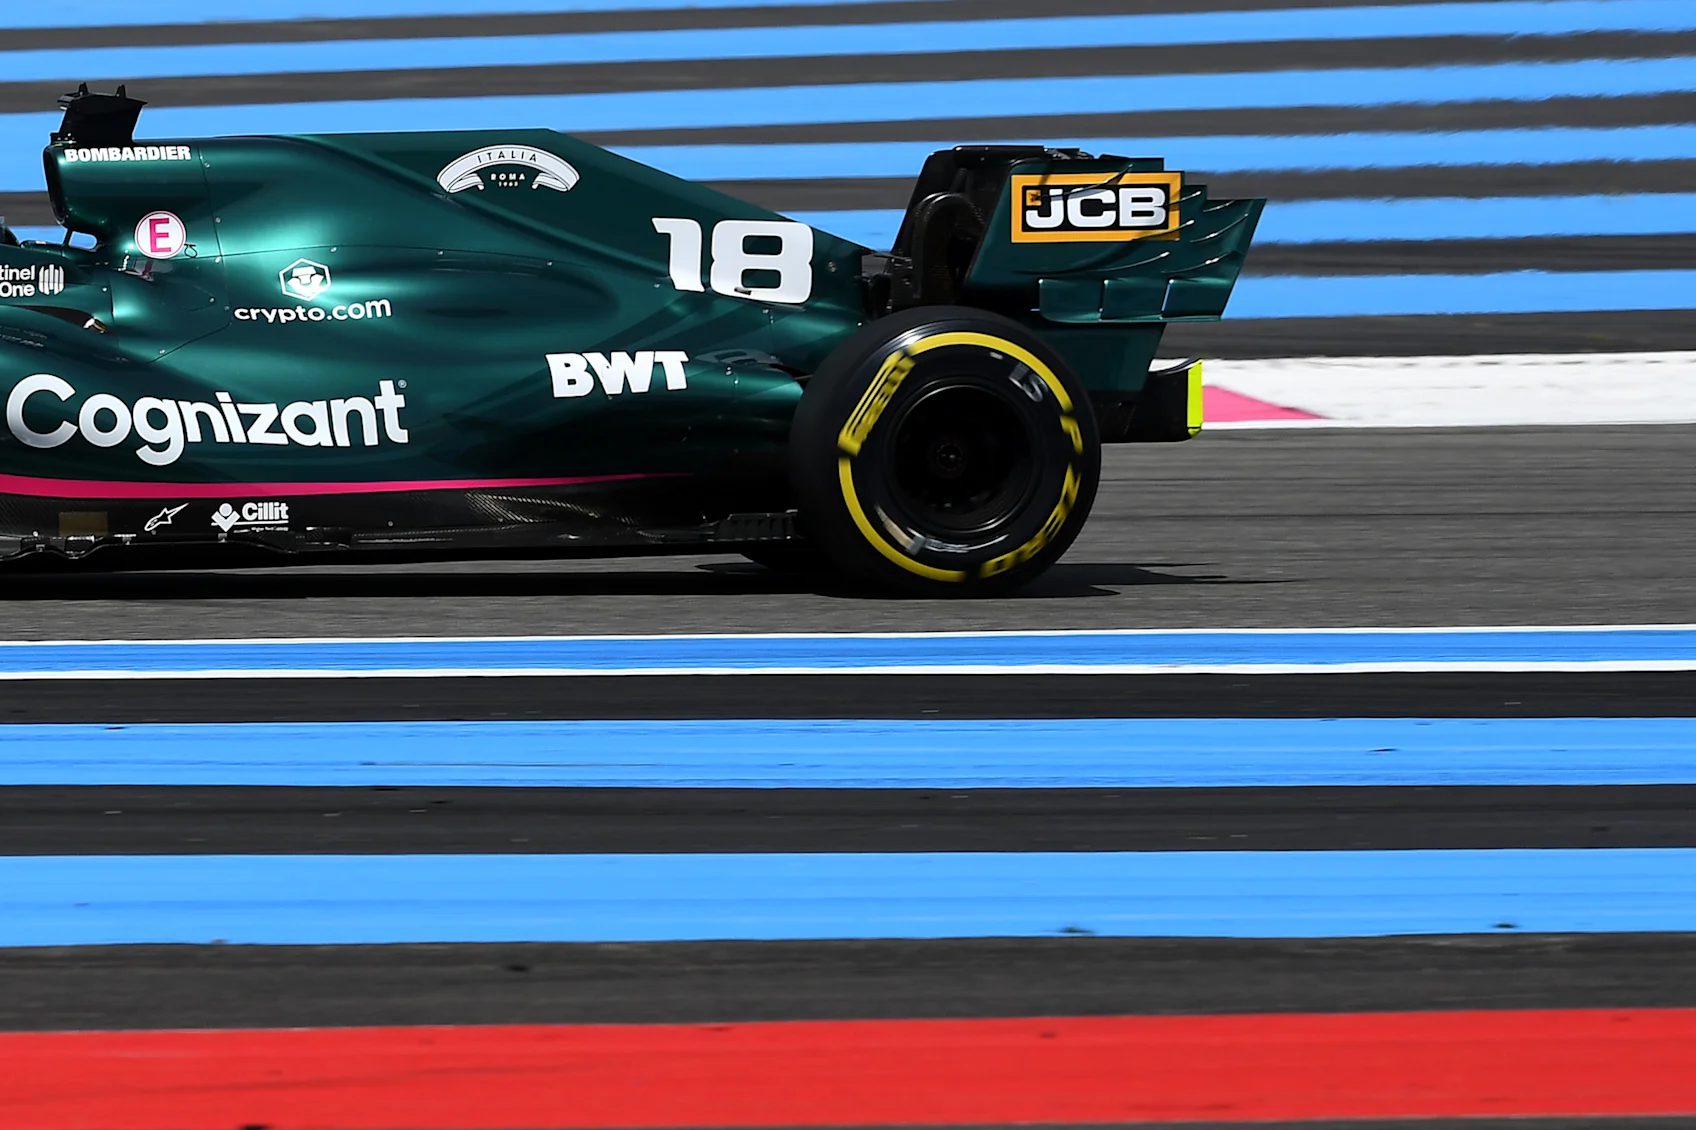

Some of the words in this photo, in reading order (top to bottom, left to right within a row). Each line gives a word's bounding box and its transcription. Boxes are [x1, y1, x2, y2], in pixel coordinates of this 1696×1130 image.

[64, 145, 191, 162] BOMBARDIER
[477, 150, 538, 163] ITALIA
[490, 173, 526, 181] ROMA
[1025, 187, 1166, 228] JCB
[149, 218, 172, 253] E
[651, 217, 814, 304] 18
[234, 298, 392, 323] crypto.com
[545, 351, 689, 398] BWT
[6, 373, 409, 466] Cognizant
[242, 502, 289, 521] Cillit
